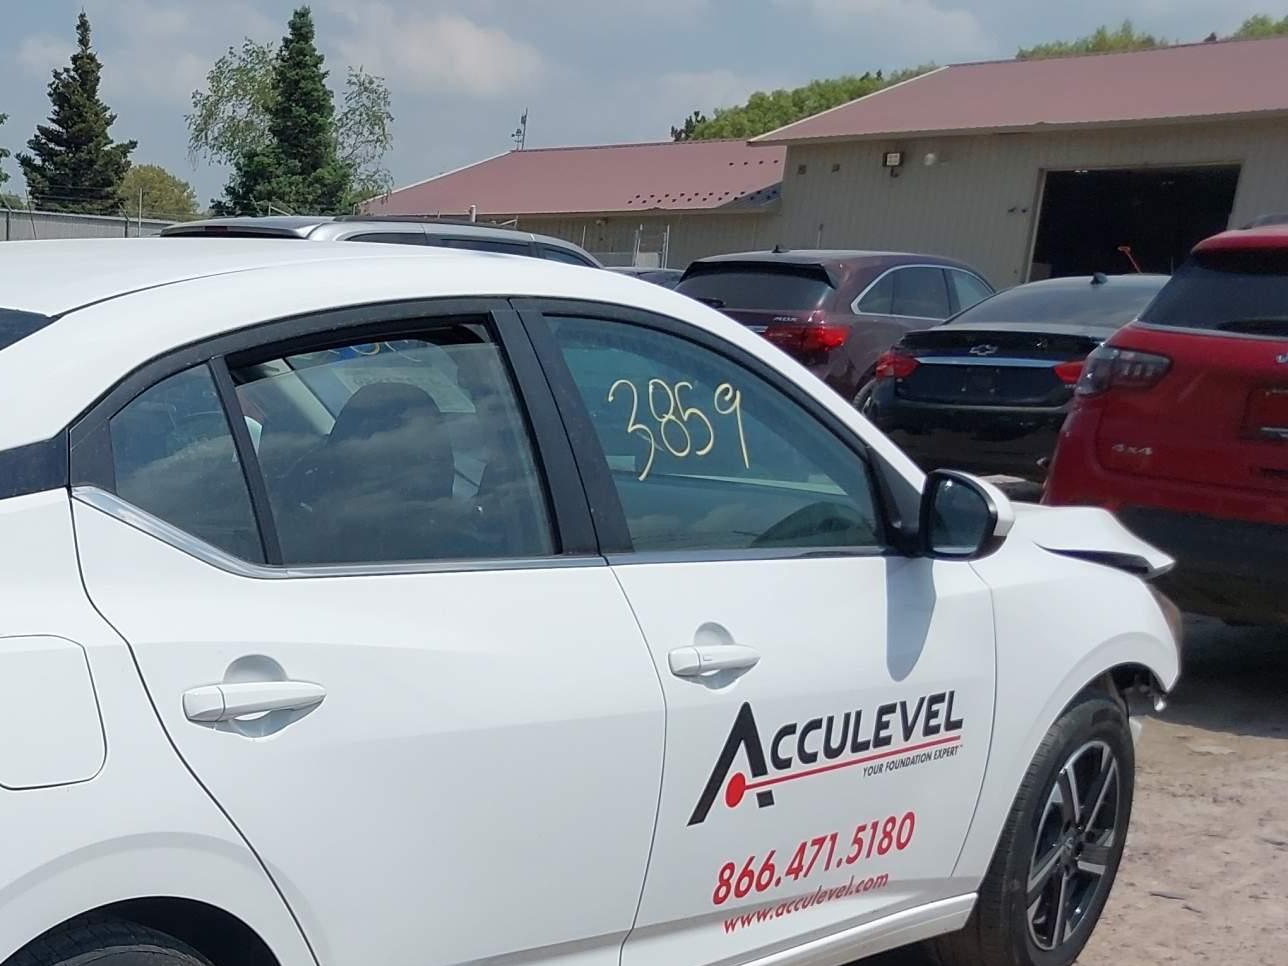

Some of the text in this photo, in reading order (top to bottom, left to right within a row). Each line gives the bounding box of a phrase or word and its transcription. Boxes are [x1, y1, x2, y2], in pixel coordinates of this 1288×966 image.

[608, 379, 750, 481] 3859
[686, 689, 964, 827] ACCULEVEL
[863, 745, 959, 777] YOUR FOUNDATION EXPERT
[711, 810, 916, 906] 866.471.5180
[723, 871, 889, 935] www.acculevel.com
